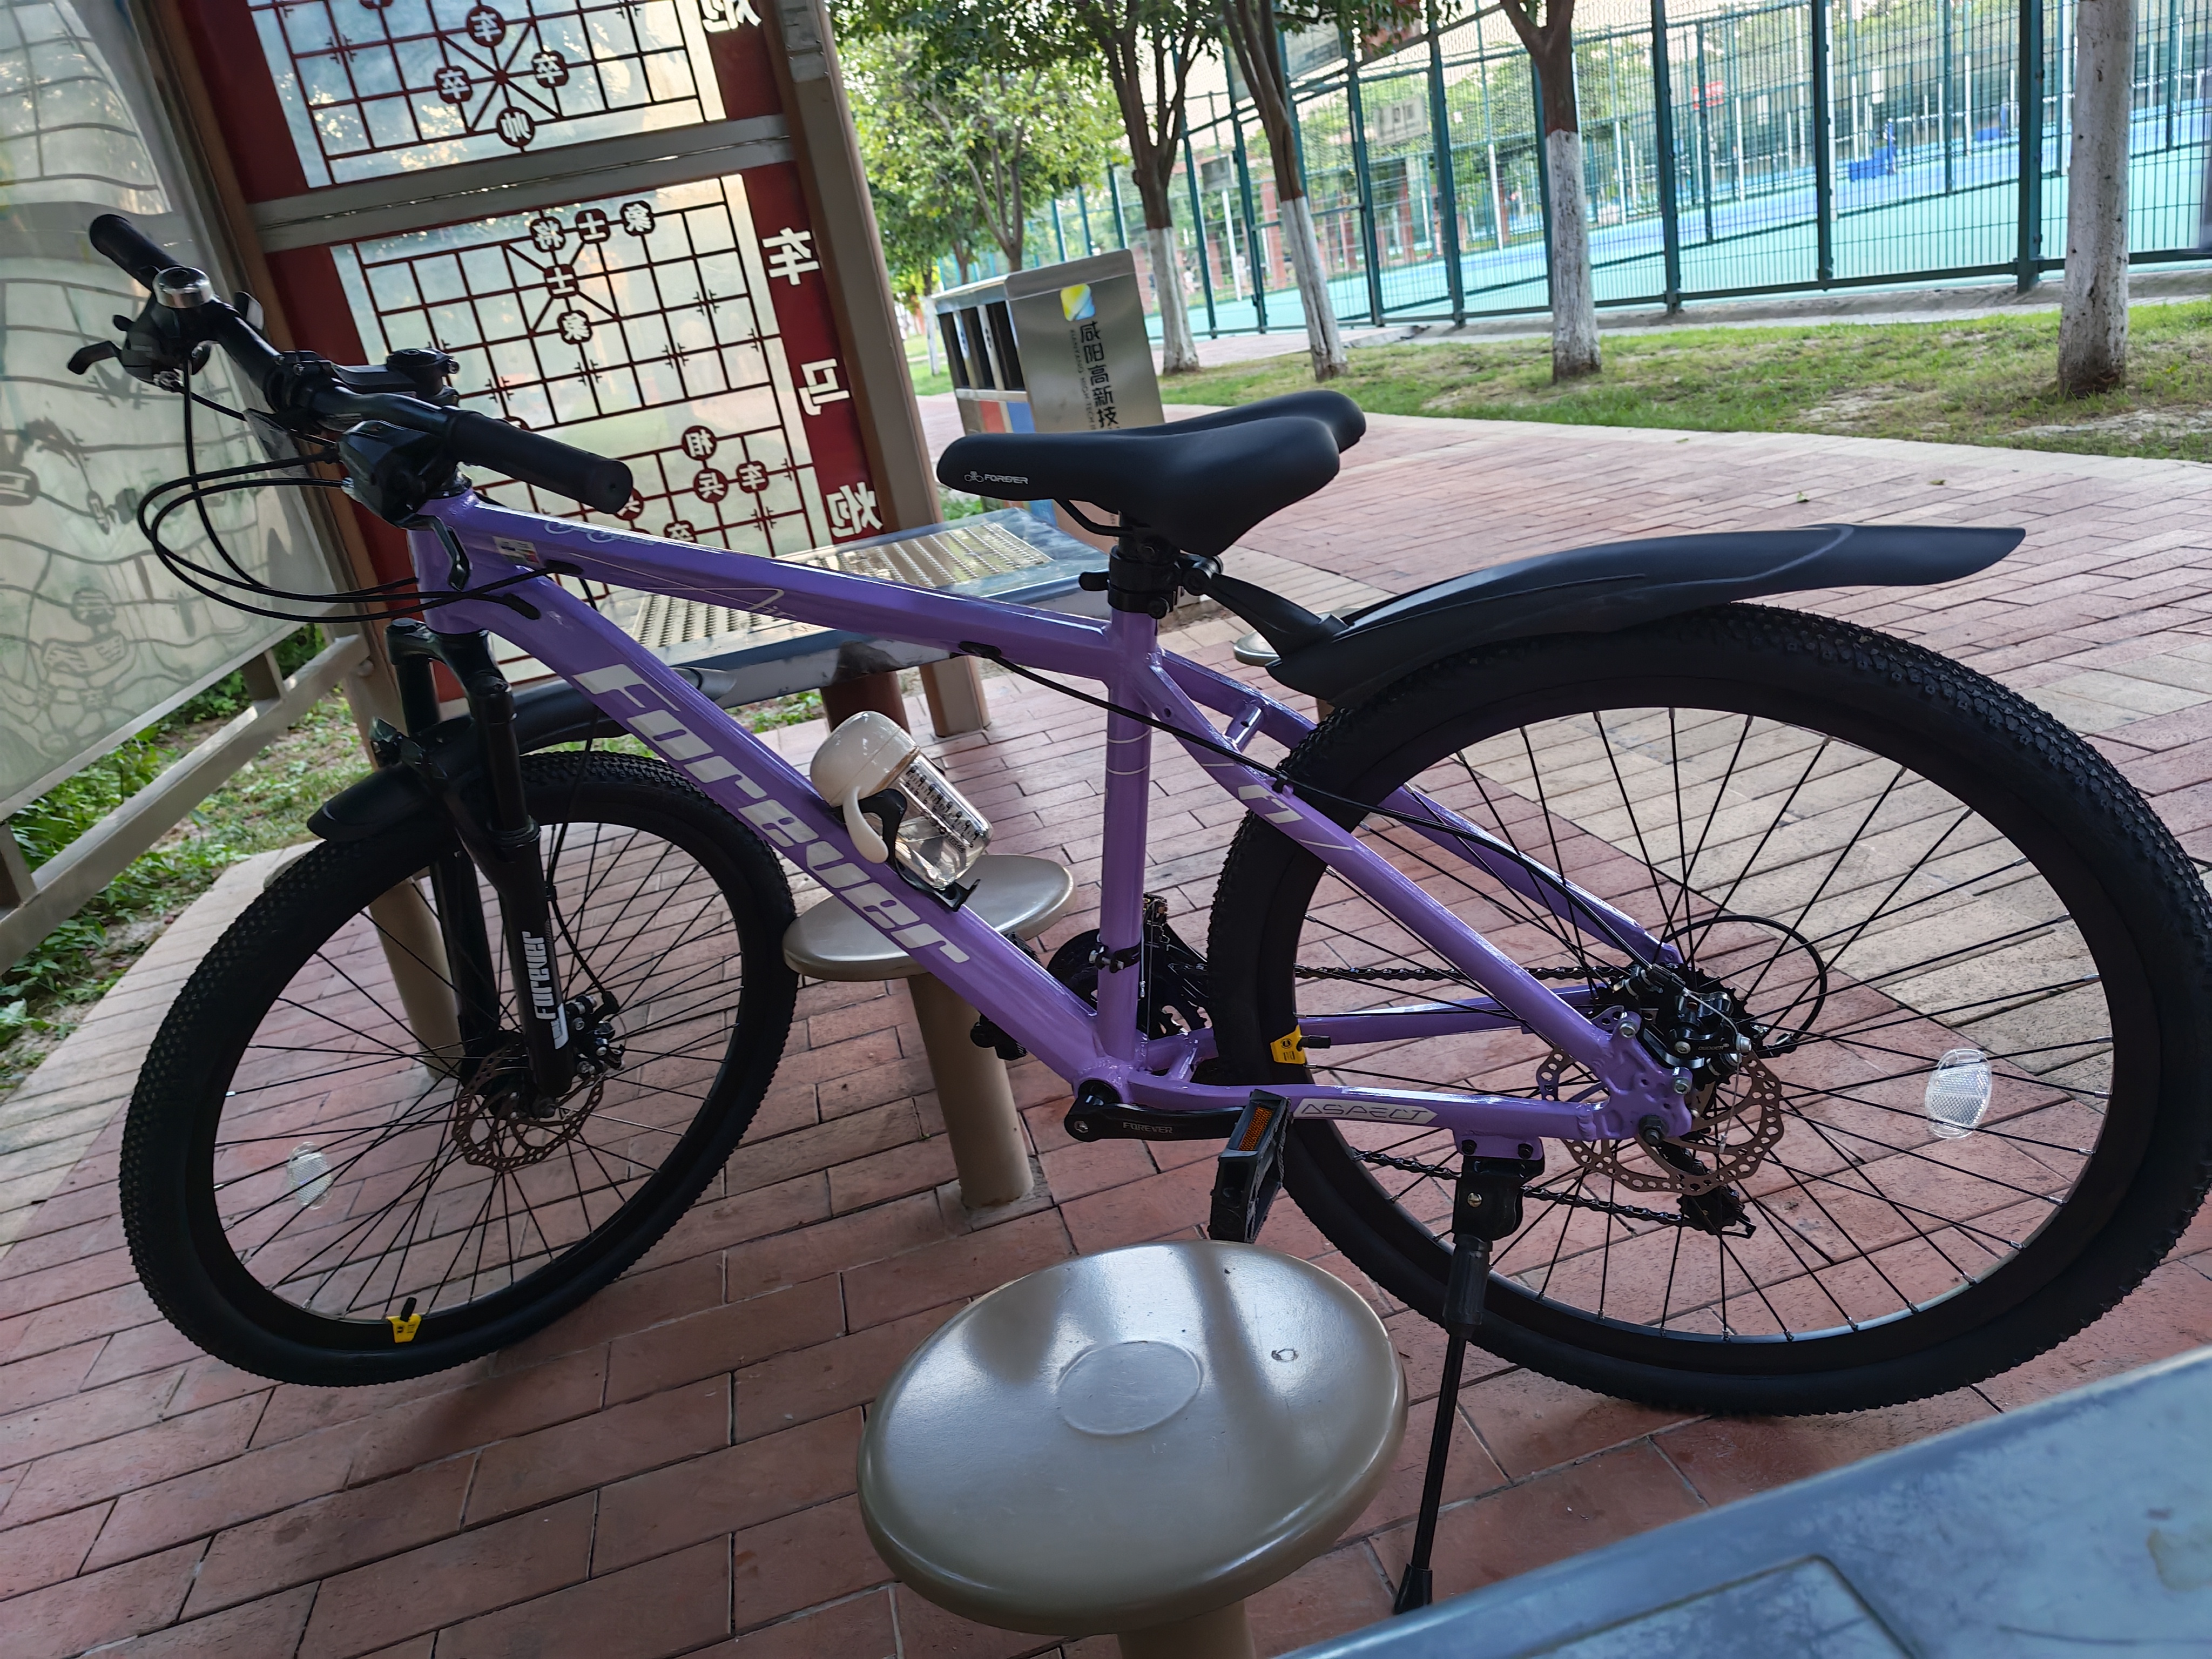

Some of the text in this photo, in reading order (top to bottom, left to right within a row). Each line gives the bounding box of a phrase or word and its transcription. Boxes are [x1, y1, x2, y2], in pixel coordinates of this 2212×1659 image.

[1080, 321, 1120, 429] 咸阳高新技
[1301, 1103, 1428, 1121] ASPECT
[1123, 1122, 1173, 1134] FOREVER
